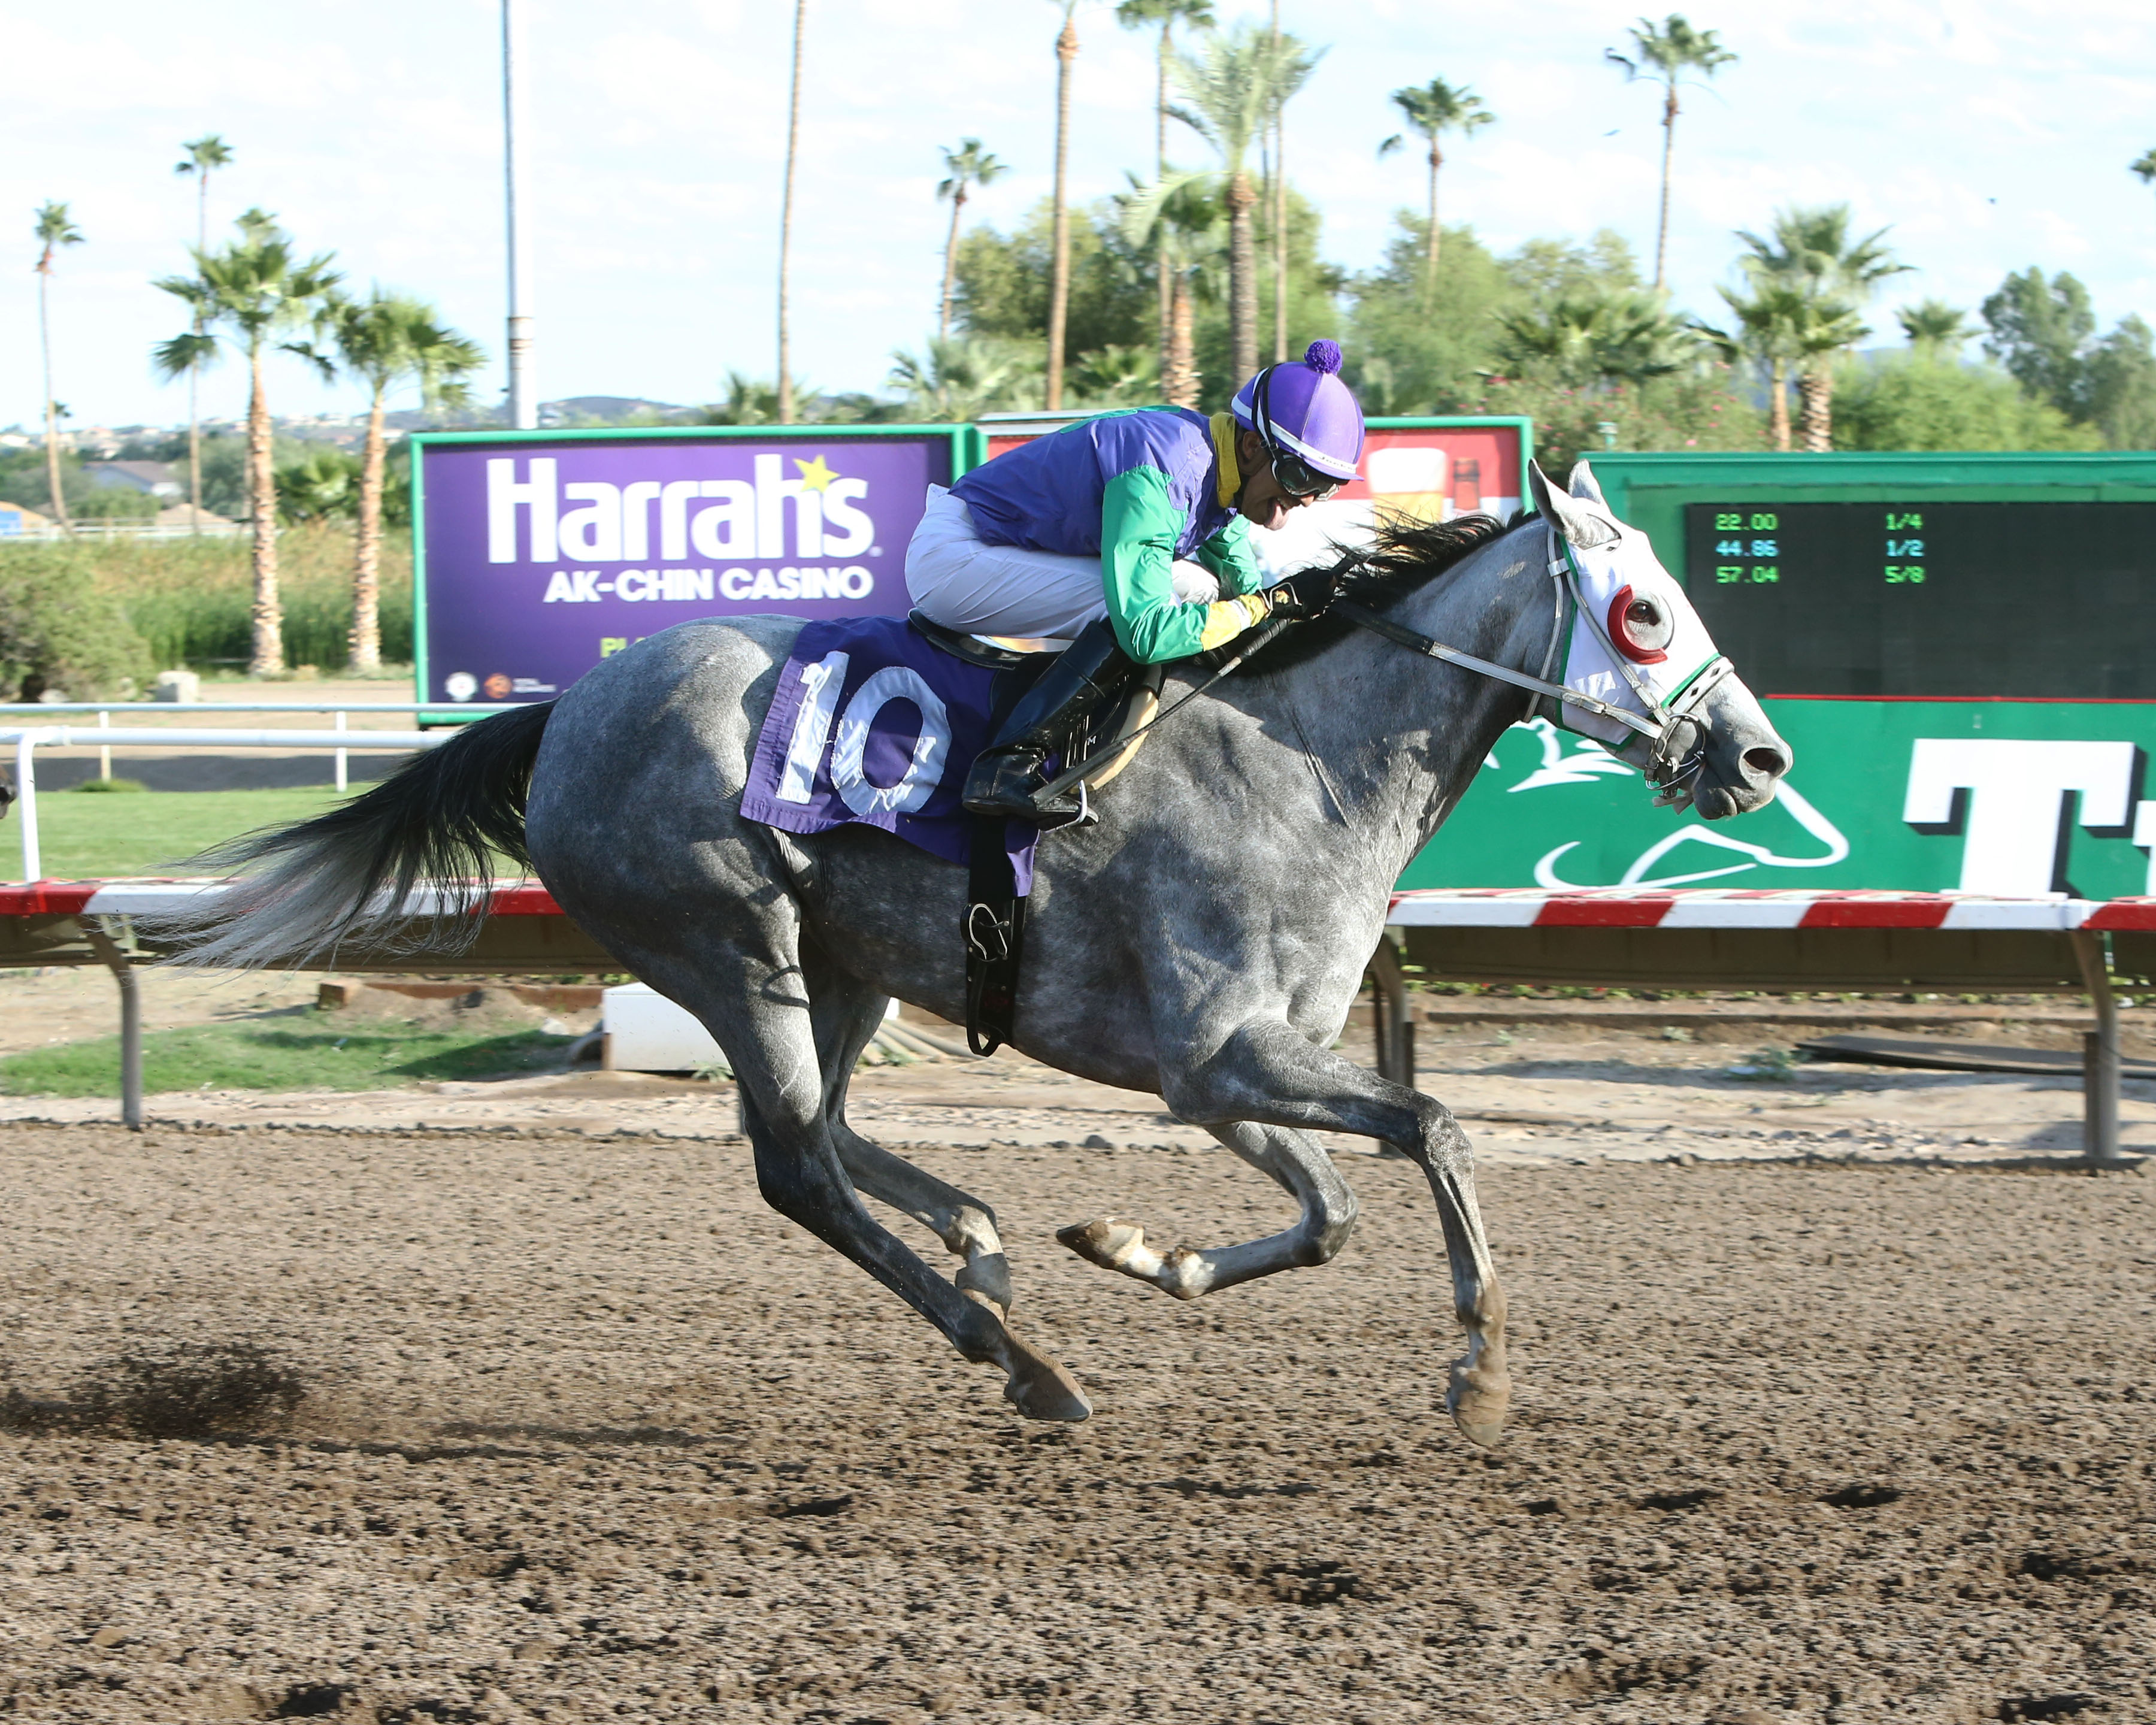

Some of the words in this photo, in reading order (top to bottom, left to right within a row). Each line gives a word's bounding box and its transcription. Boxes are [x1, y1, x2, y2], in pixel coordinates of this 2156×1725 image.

[1715, 513, 1779, 531] 22.00
[1885, 513, 1924, 531] 1/4
[1886, 539, 1925, 558] 1/2
[543, 568, 714, 603] AK-CHIN
[718, 565, 874, 601] CASINO
[1716, 565, 1780, 584] 57.04
[1884, 565, 1926, 584] 5/8
[775, 650, 952, 816] 10
